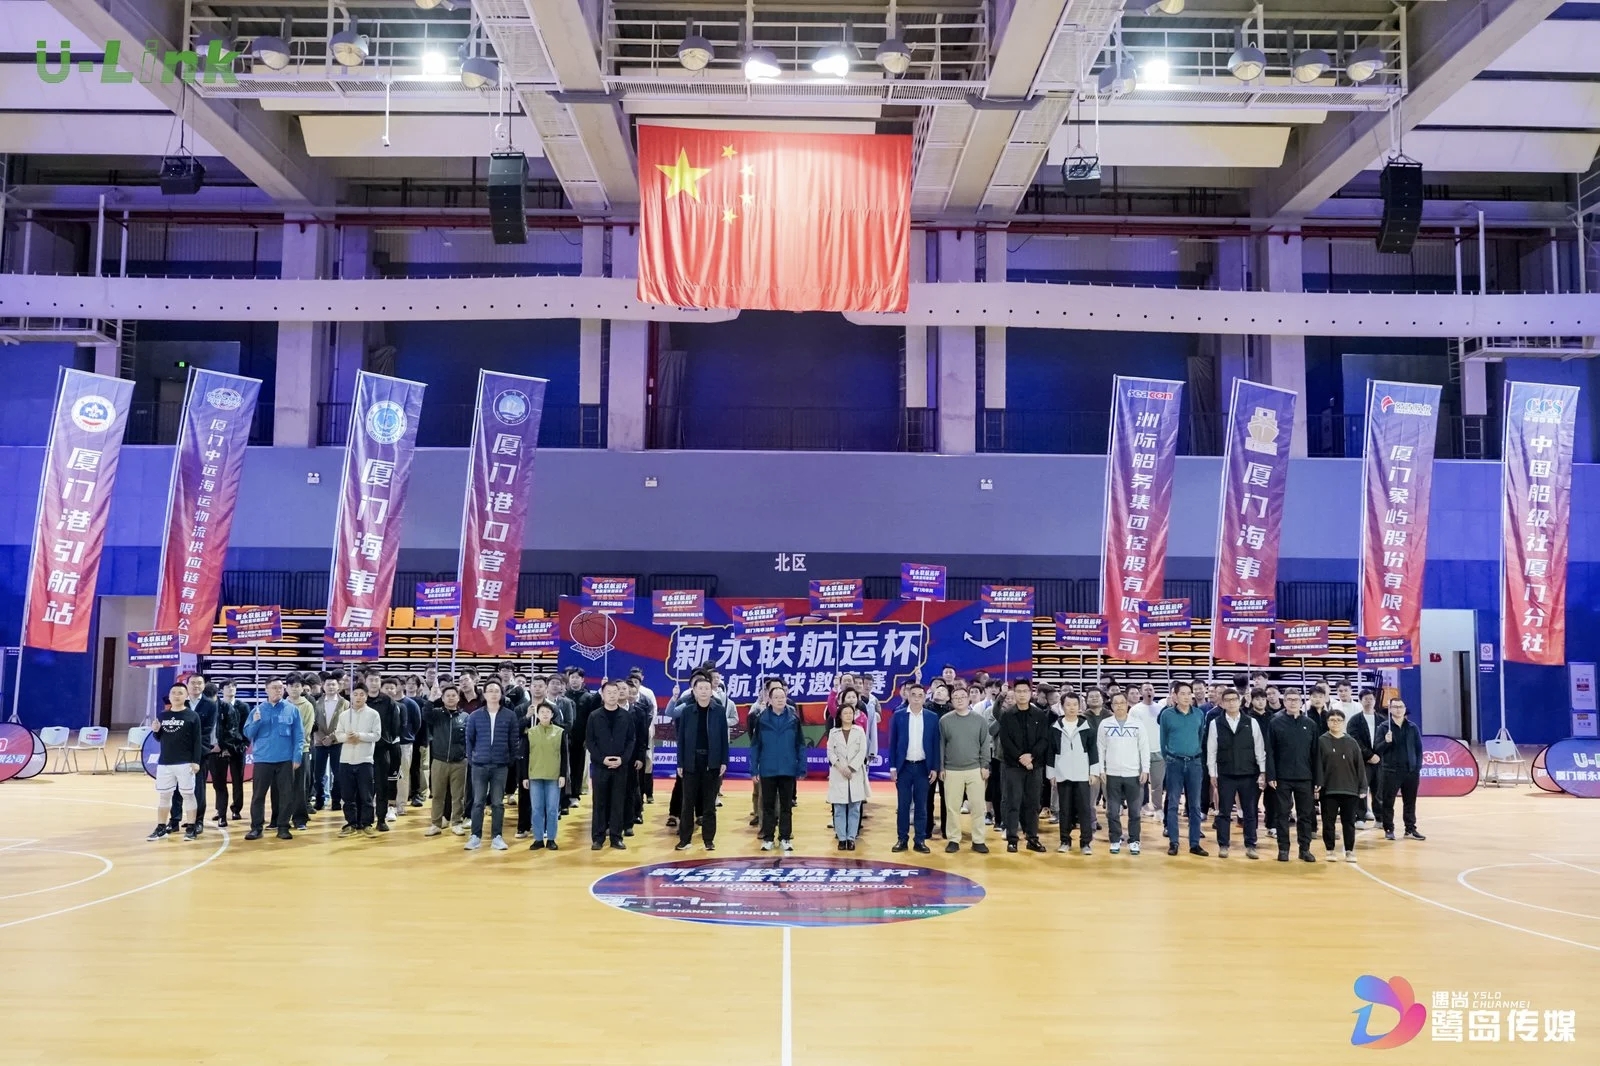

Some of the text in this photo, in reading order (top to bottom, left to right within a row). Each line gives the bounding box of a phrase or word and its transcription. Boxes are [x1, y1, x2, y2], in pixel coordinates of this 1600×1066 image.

[1127, 388, 1174, 400] seacon
[1525, 397, 1564, 414] CCS
[42, 447, 103, 625] 厦门港引航站
[178, 418, 228, 647] 厦门中远海运物流供应链有限公司
[341, 457, 396, 628] 厦门海事局
[471, 432, 523, 632] 厦门港口管理局
[774, 552, 807, 572] 北区
[1117, 411, 1161, 656] 洲际船务集团控股有限公司
[1226, 461, 1274, 646] 厦门海事院
[1379, 444, 1415, 633] 厦门象屿股份有限公
[1521, 434, 1553, 653] 中国船级社厦门分社
[672, 628, 921, 671] 新永联航运杯
[1555, 770, 1600, 781] 厦门新永
